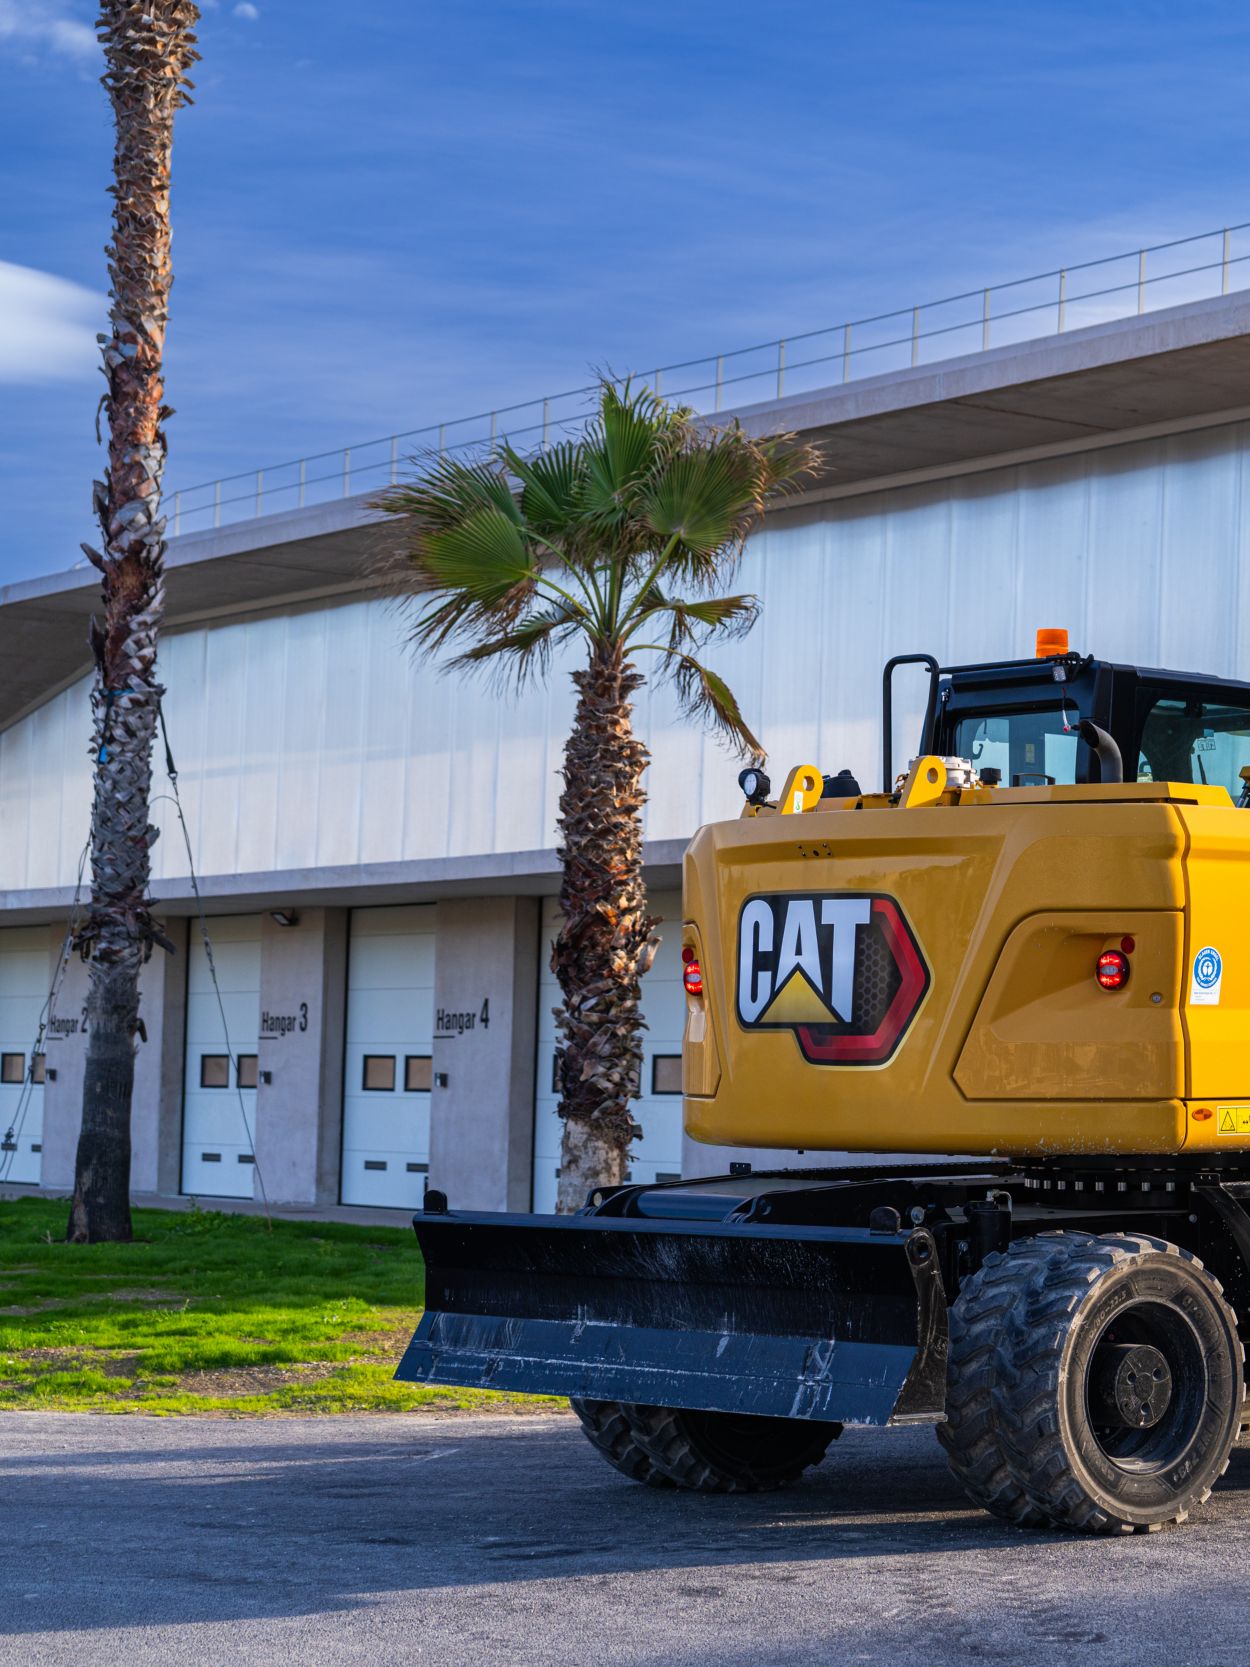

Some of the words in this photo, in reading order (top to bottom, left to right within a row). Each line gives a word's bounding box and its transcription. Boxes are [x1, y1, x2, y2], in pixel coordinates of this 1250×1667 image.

[738, 898, 871, 1023] CAT
[49, 1014, 79, 1038] Hangar
[81, 1006, 89, 1033] 2
[261, 1011, 297, 1037] Hangar
[299, 1002, 309, 1033] 3
[436, 1008, 477, 1035] Hangar
[480, 997, 490, 1030] 4
